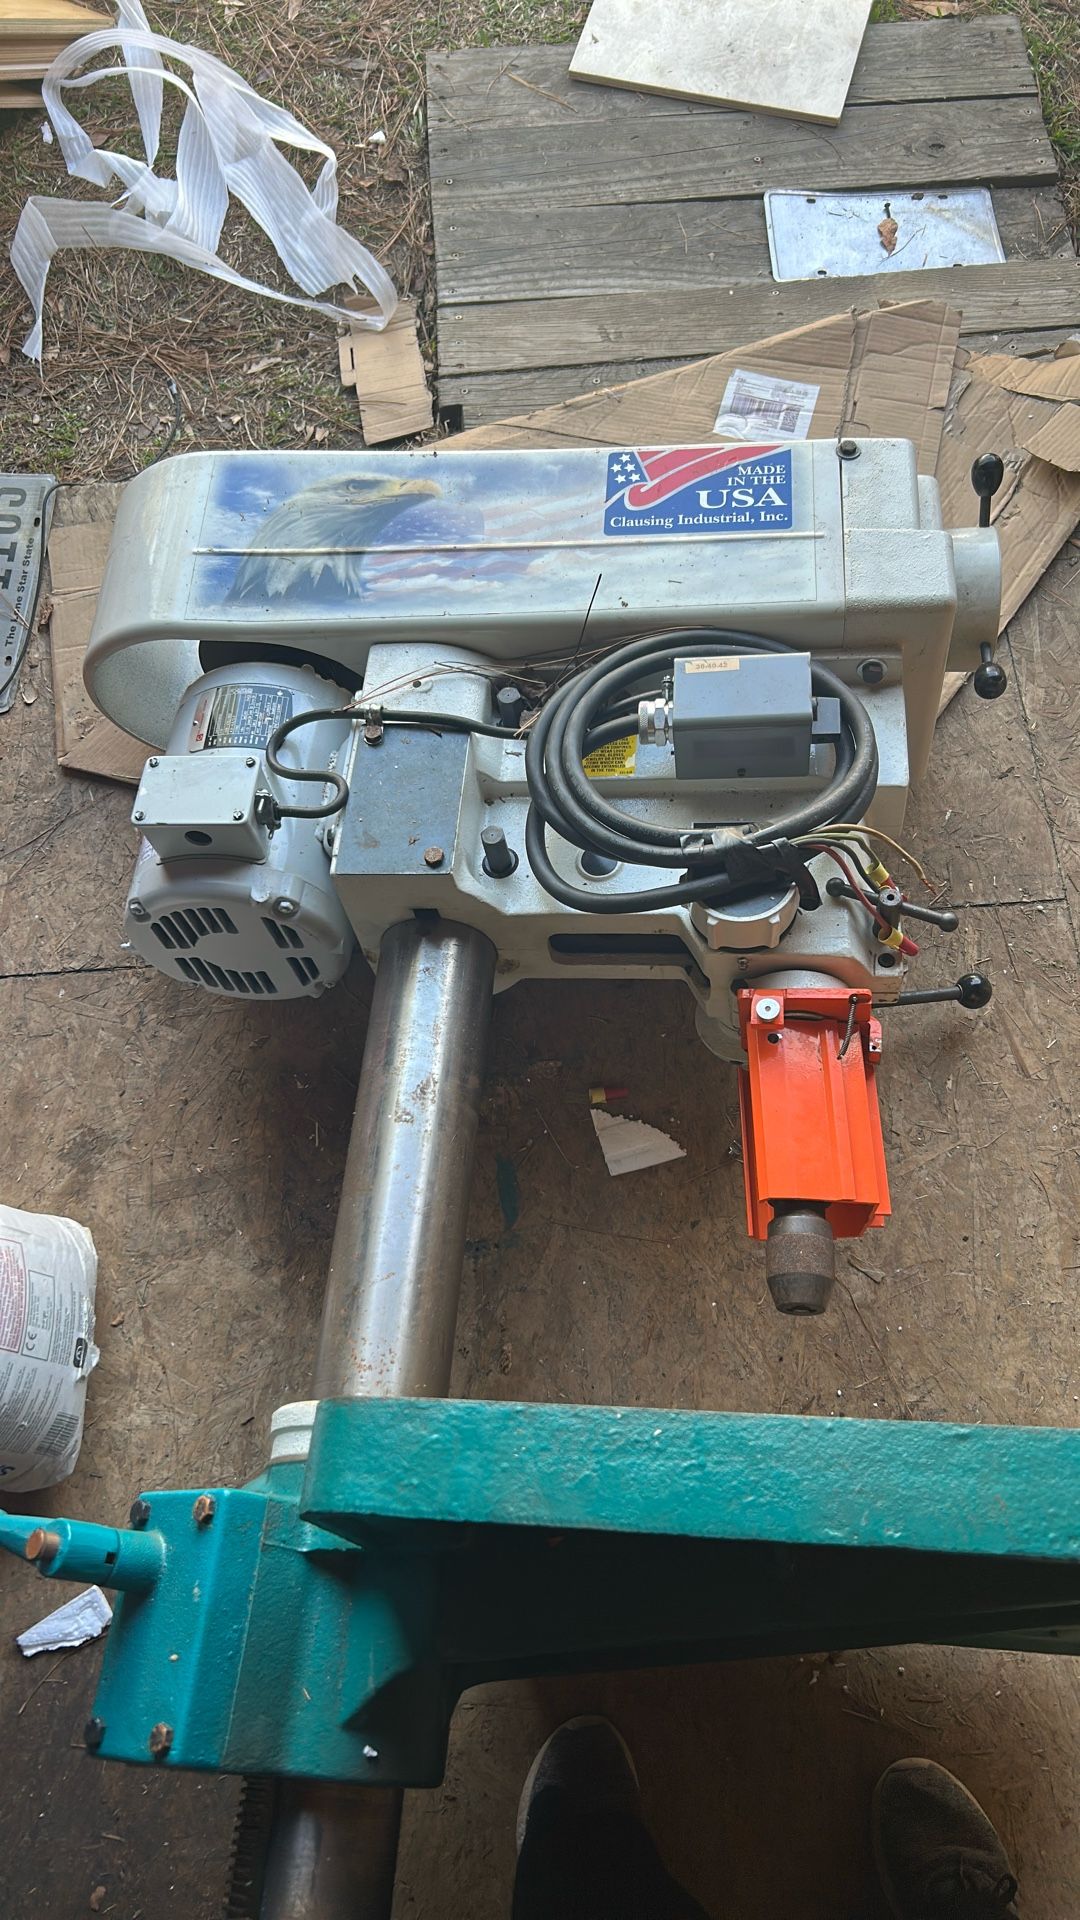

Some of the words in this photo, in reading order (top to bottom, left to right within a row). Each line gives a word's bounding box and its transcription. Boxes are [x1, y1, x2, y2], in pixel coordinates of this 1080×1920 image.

[727, 477, 745, 486] IN
[751, 475, 786, 485] THE
[738, 465, 786, 476] MADE
[695, 487, 787, 509] USA
[610, 516, 674, 529] Clausing
[677, 511, 755, 526] Industrial,
[759, 511, 788, 522] Inc.
[22, 537, 35, 567] State
[17, 570, 28, 593] Star
[5, 626, 17, 647] The
